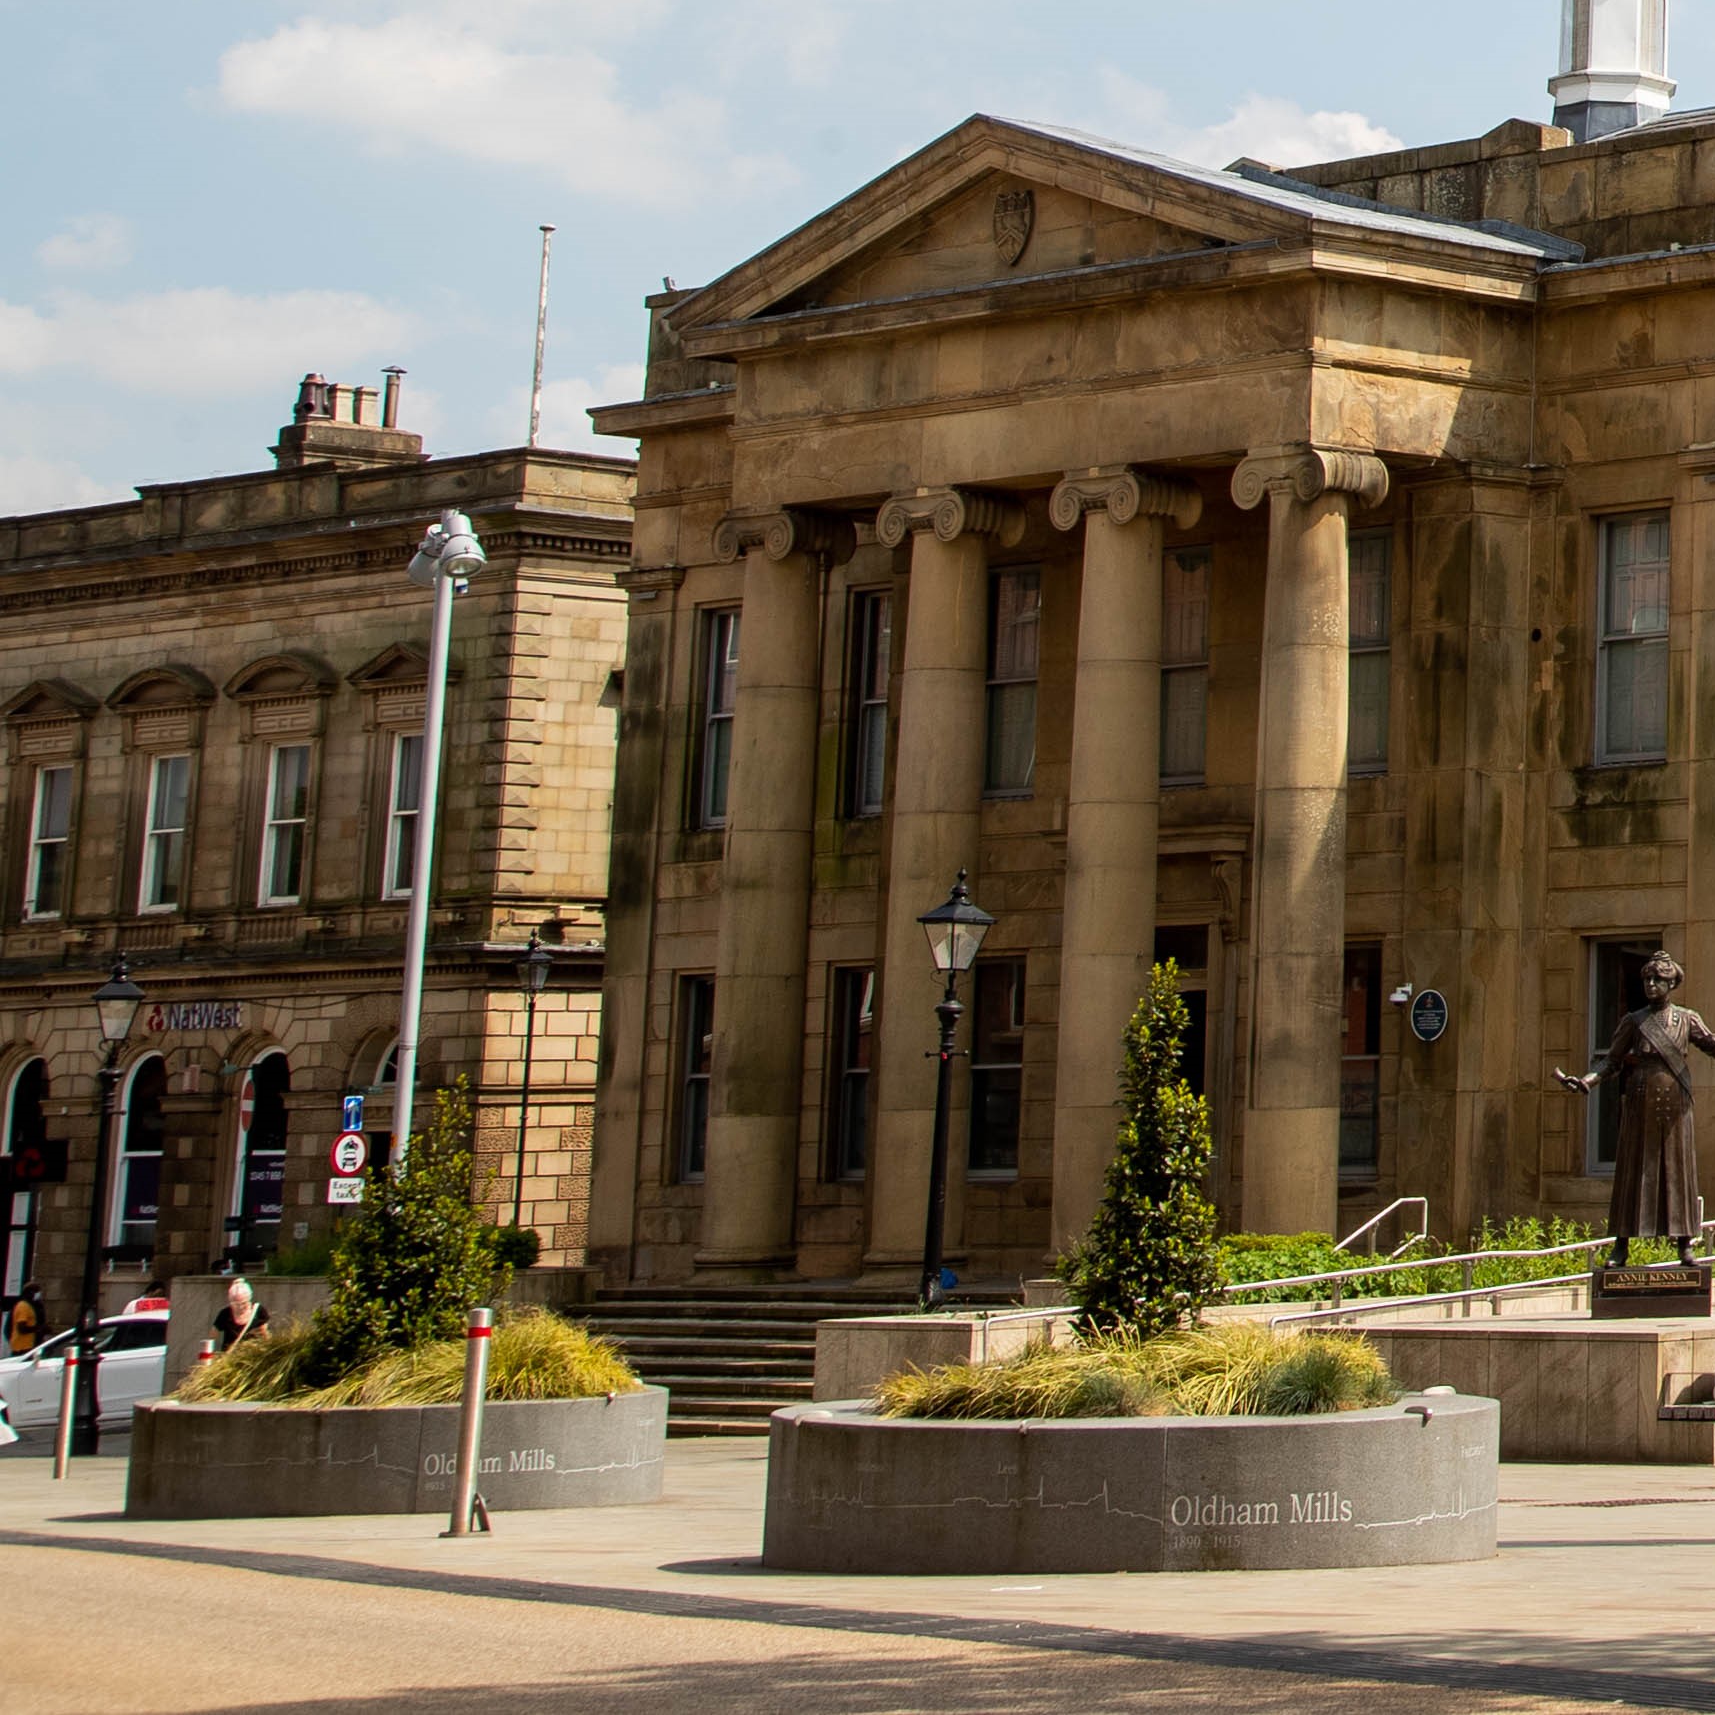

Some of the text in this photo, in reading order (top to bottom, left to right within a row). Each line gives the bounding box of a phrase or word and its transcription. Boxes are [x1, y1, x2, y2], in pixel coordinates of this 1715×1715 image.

[168, 1002, 242, 1030] NatWest
[333, 1181, 361, 1189] Except
[1616, 1271, 1647, 1283] ANNIE
[1649, 1270, 1688, 1282] KENNEY
[423, 1448, 556, 1477] Oldam Mills
[1171, 1491, 1353, 1527] Oldham Mills
